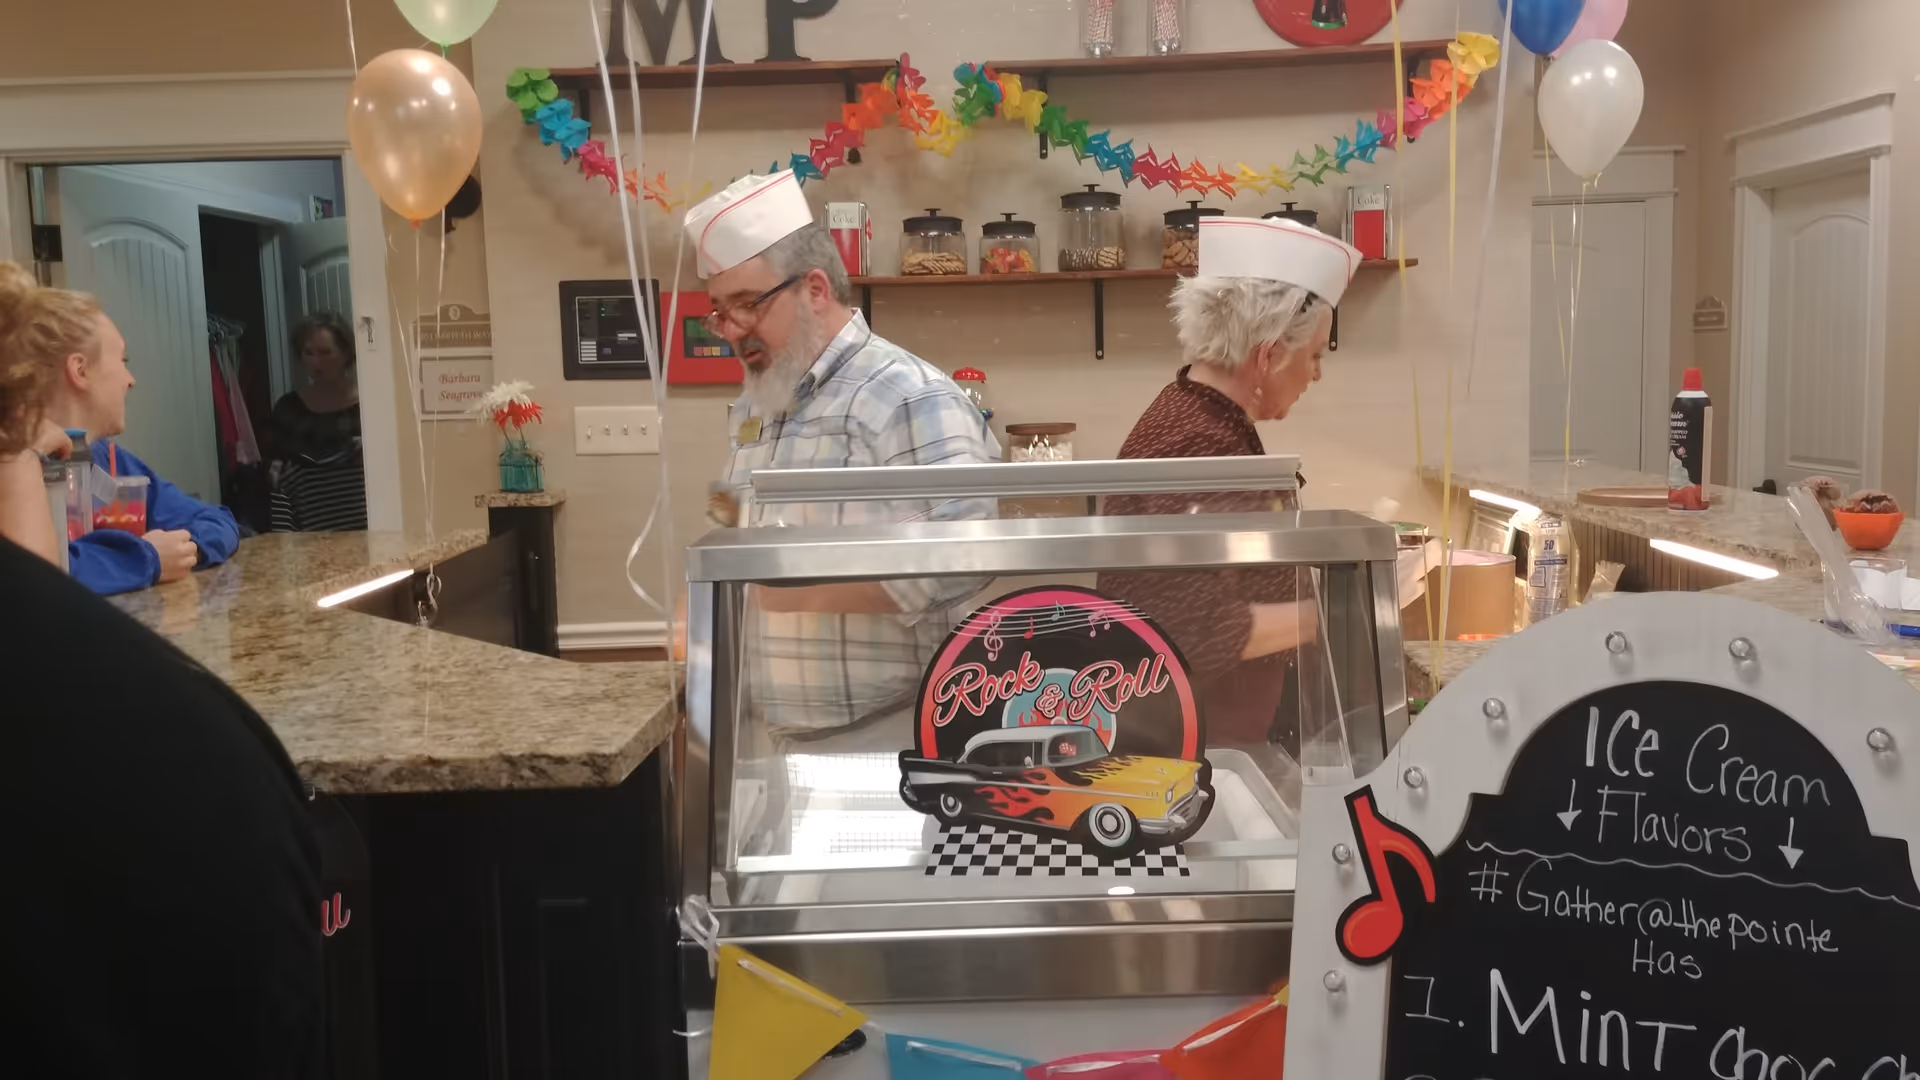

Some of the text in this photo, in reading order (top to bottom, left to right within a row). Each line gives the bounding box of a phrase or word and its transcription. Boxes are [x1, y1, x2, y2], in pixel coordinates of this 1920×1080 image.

[832, 211, 854, 224] Coke
[438, 371, 481, 385] Barbara
[932, 651, 1171, 728] Rock & Roll
[1686, 723, 1831, 807] Cream
[1597, 784, 1752, 863] Flavors
[1631, 938, 1703, 980] Has
